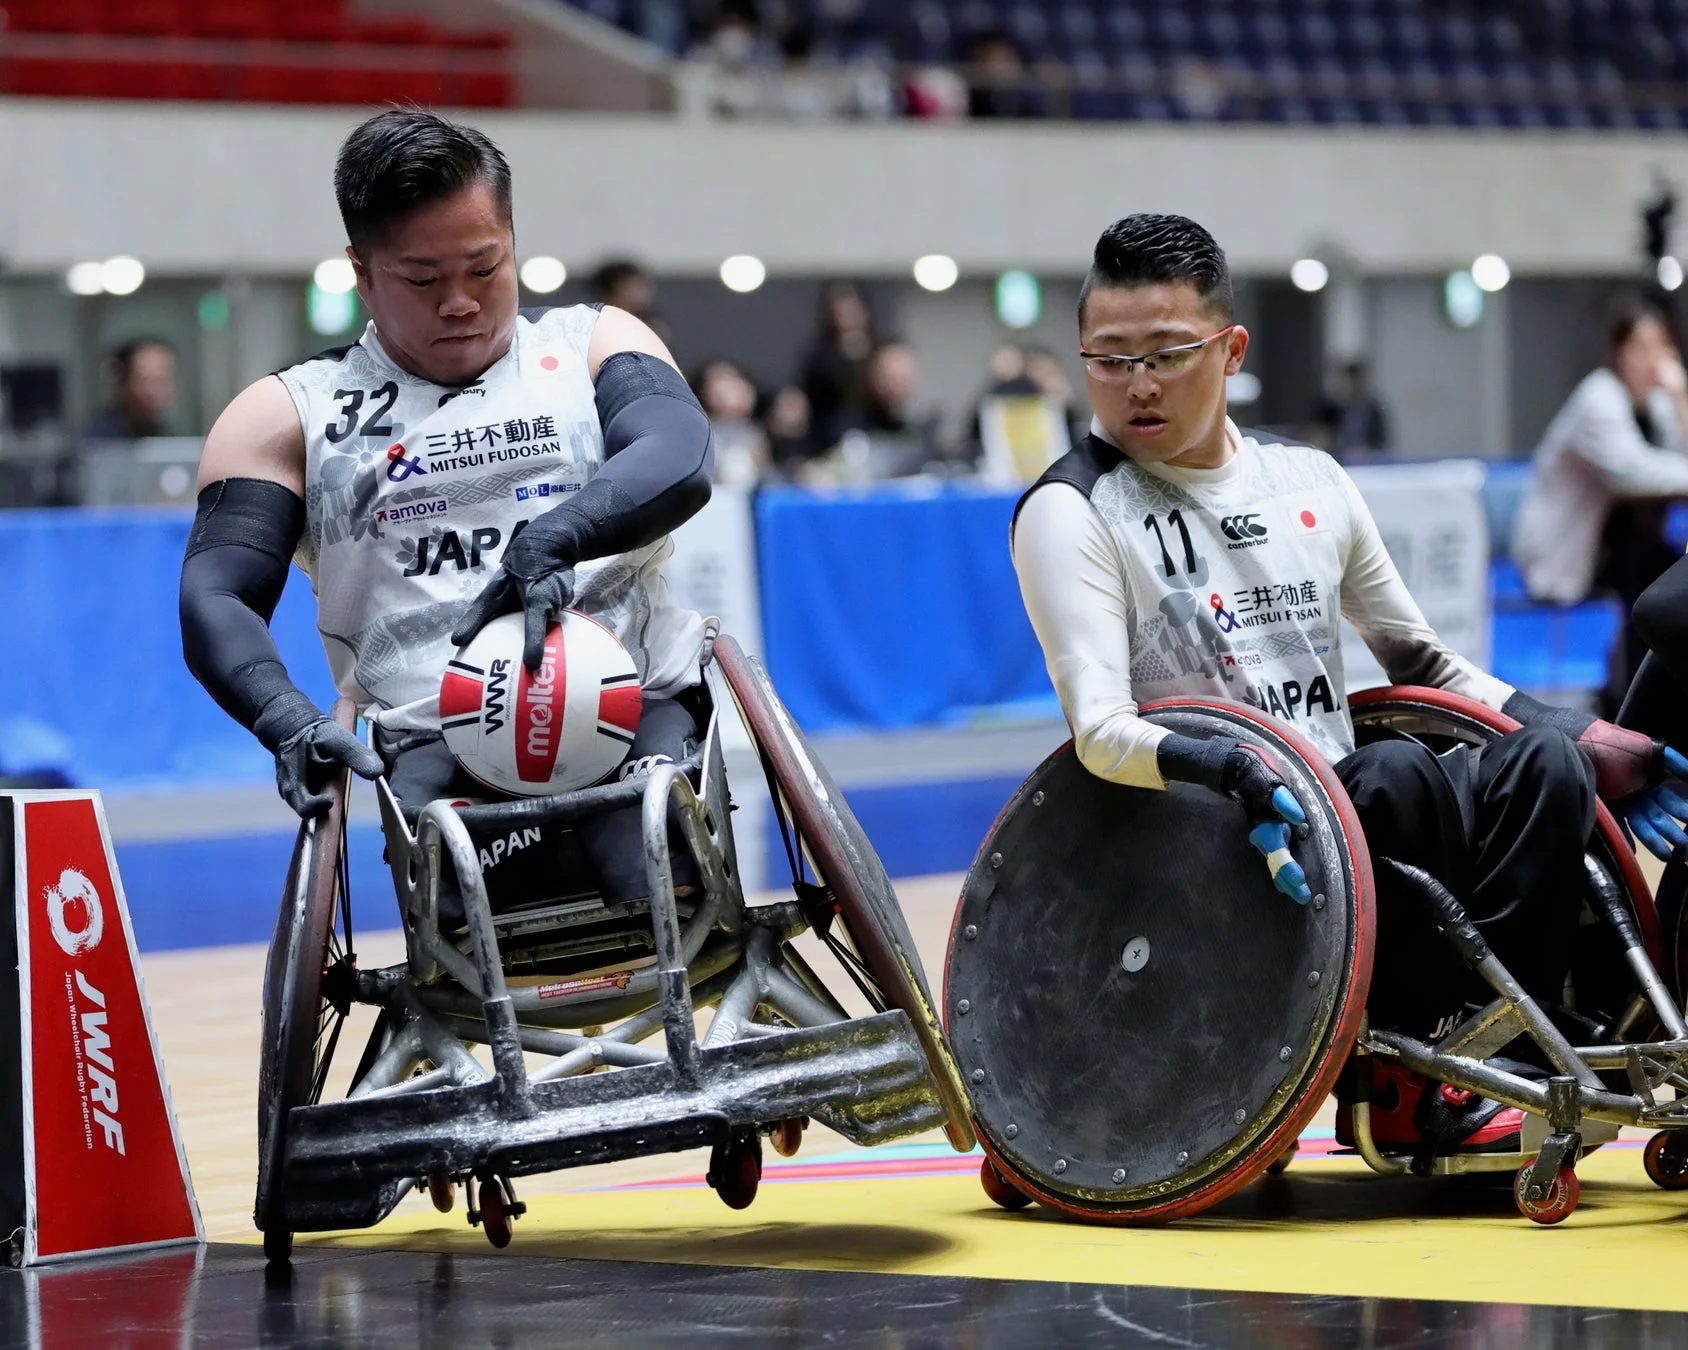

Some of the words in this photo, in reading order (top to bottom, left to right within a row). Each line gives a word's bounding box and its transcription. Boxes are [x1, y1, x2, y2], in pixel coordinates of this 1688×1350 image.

[325, 381, 399, 443] 32
[425, 415, 558, 457] 三井不動産
[430, 454, 484, 474] MITSUI
[488, 441, 561, 463] FUDOSAN
[389, 500, 447, 520] amova
[516, 485, 549, 500] MOL
[403, 519, 530, 577] JAP
[1143, 509, 1197, 578] 11
[1227, 538, 1268, 550] canterbur
[1241, 611, 1281, 628] MITSUI
[527, 647, 557, 757] molten
[1257, 674, 1341, 720] APA
[479, 826, 542, 874] APAN
[64, 971, 74, 1003] Japan
[69, 1004, 82, 1060] Wheelchair
[76, 1062, 86, 1094] Rugby
[81, 1095, 93, 1150] Federation
[75, 968, 125, 1156] JWRF
